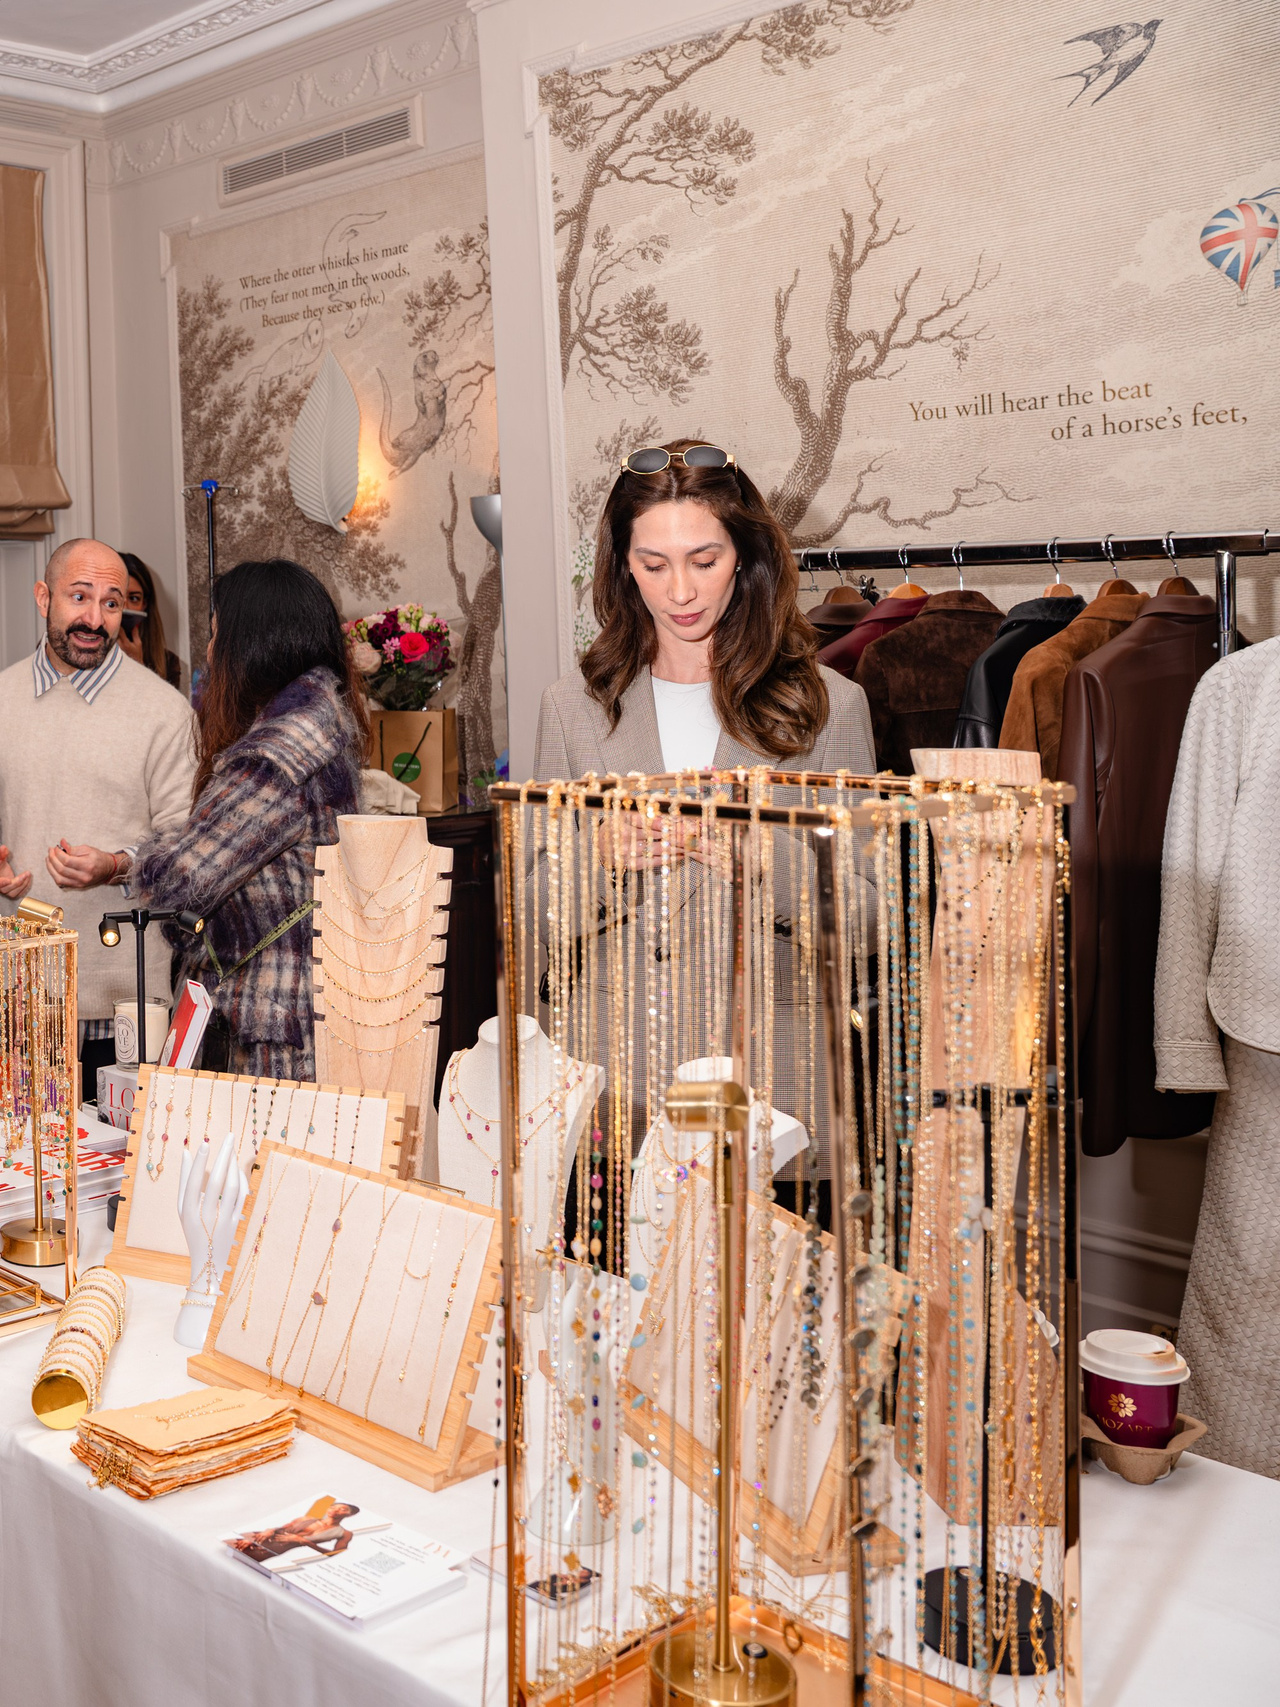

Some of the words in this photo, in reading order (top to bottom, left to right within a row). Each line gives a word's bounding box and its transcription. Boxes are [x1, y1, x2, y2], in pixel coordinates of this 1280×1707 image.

[239, 275, 271, 290] Where
[273, 269, 289, 283] the
[292, 264, 316, 278] otter
[318, 252, 360, 272] whistles
[362, 248, 379, 263] his
[381, 243, 409, 258] mate
[239, 296, 268, 313] (They
[270, 290, 289, 305] fear
[292, 286, 309, 300] not
[311, 282, 335, 295] men
[337, 278, 348, 292] in
[351, 272, 369, 287] the
[371, 263, 410, 282] woods,
[262, 313, 300, 328] Because
[302, 304, 325, 321] they
[327, 302, 343, 315] see
[345, 299, 357, 311] so
[360, 289, 386, 308] few.)
[908, 401, 948, 422] You
[955, 393, 994, 418] will
[1002, 391, 1049, 414] hear
[1056, 384, 1094, 409] the
[1101, 379, 1153, 403] beat
[1050, 416, 1077, 442] of
[1082, 422, 1094, 439] a
[1101, 406, 1183, 436] horse's
[1191, 401, 1248, 428] feet,
[109, 1083, 135, 1114] LO
[40, 1144, 125, 1171] EAR
